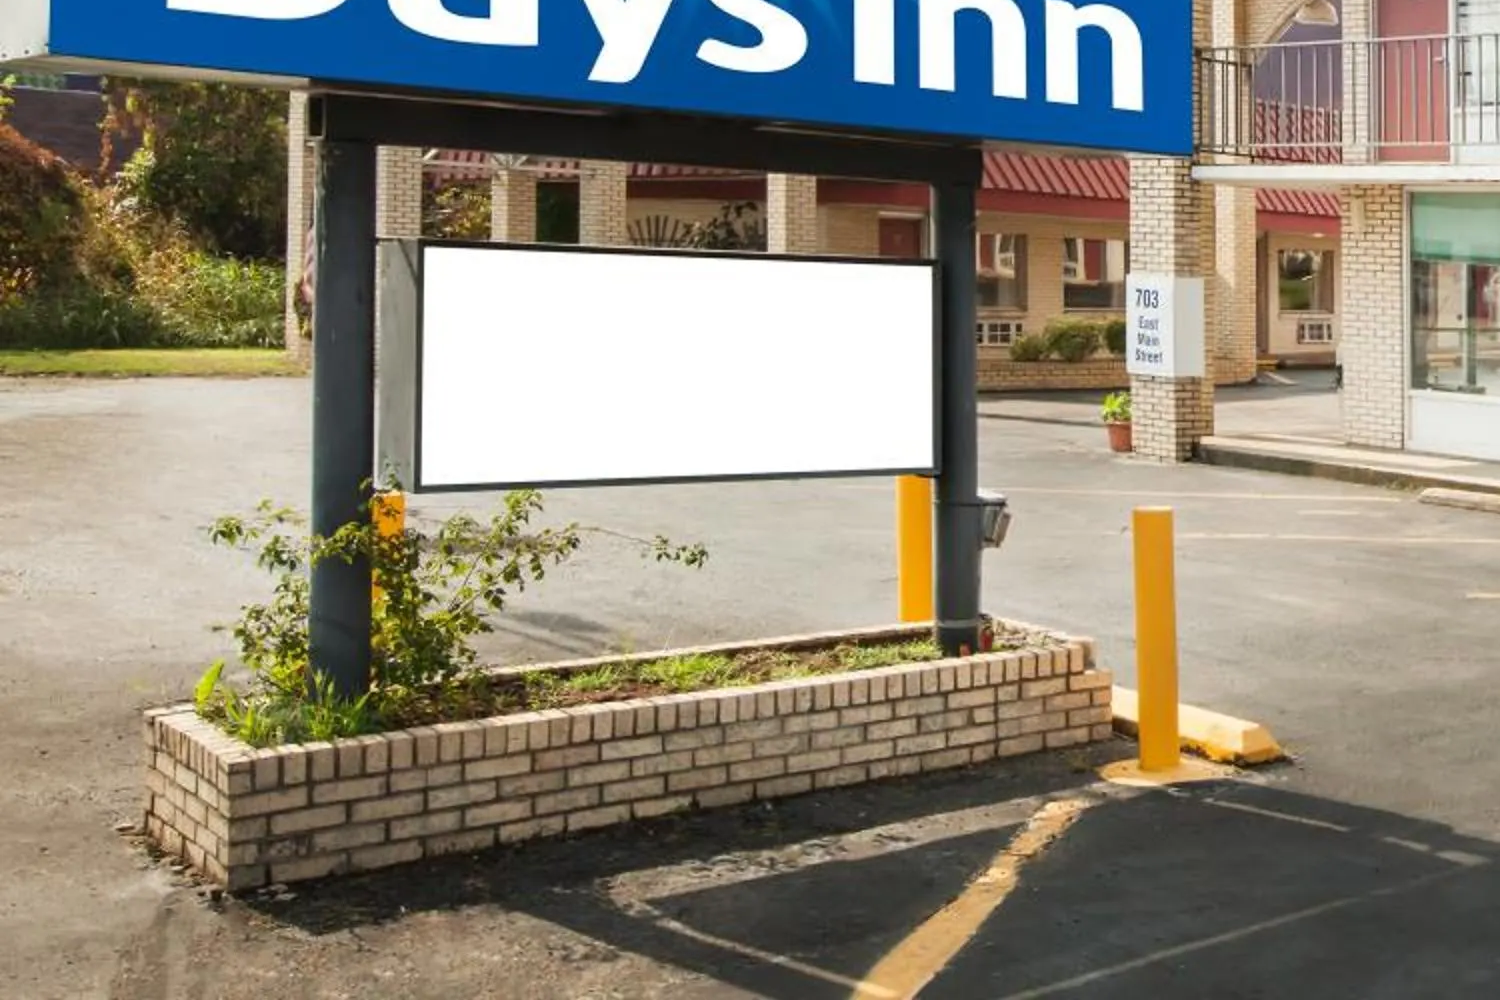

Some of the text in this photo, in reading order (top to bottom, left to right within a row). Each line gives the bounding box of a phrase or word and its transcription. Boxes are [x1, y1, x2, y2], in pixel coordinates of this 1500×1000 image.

[1135, 289, 1159, 308] 703
[1138, 315, 1159, 330] East
[1137, 332, 1160, 346] Main
[1135, 347, 1163, 363] Street
